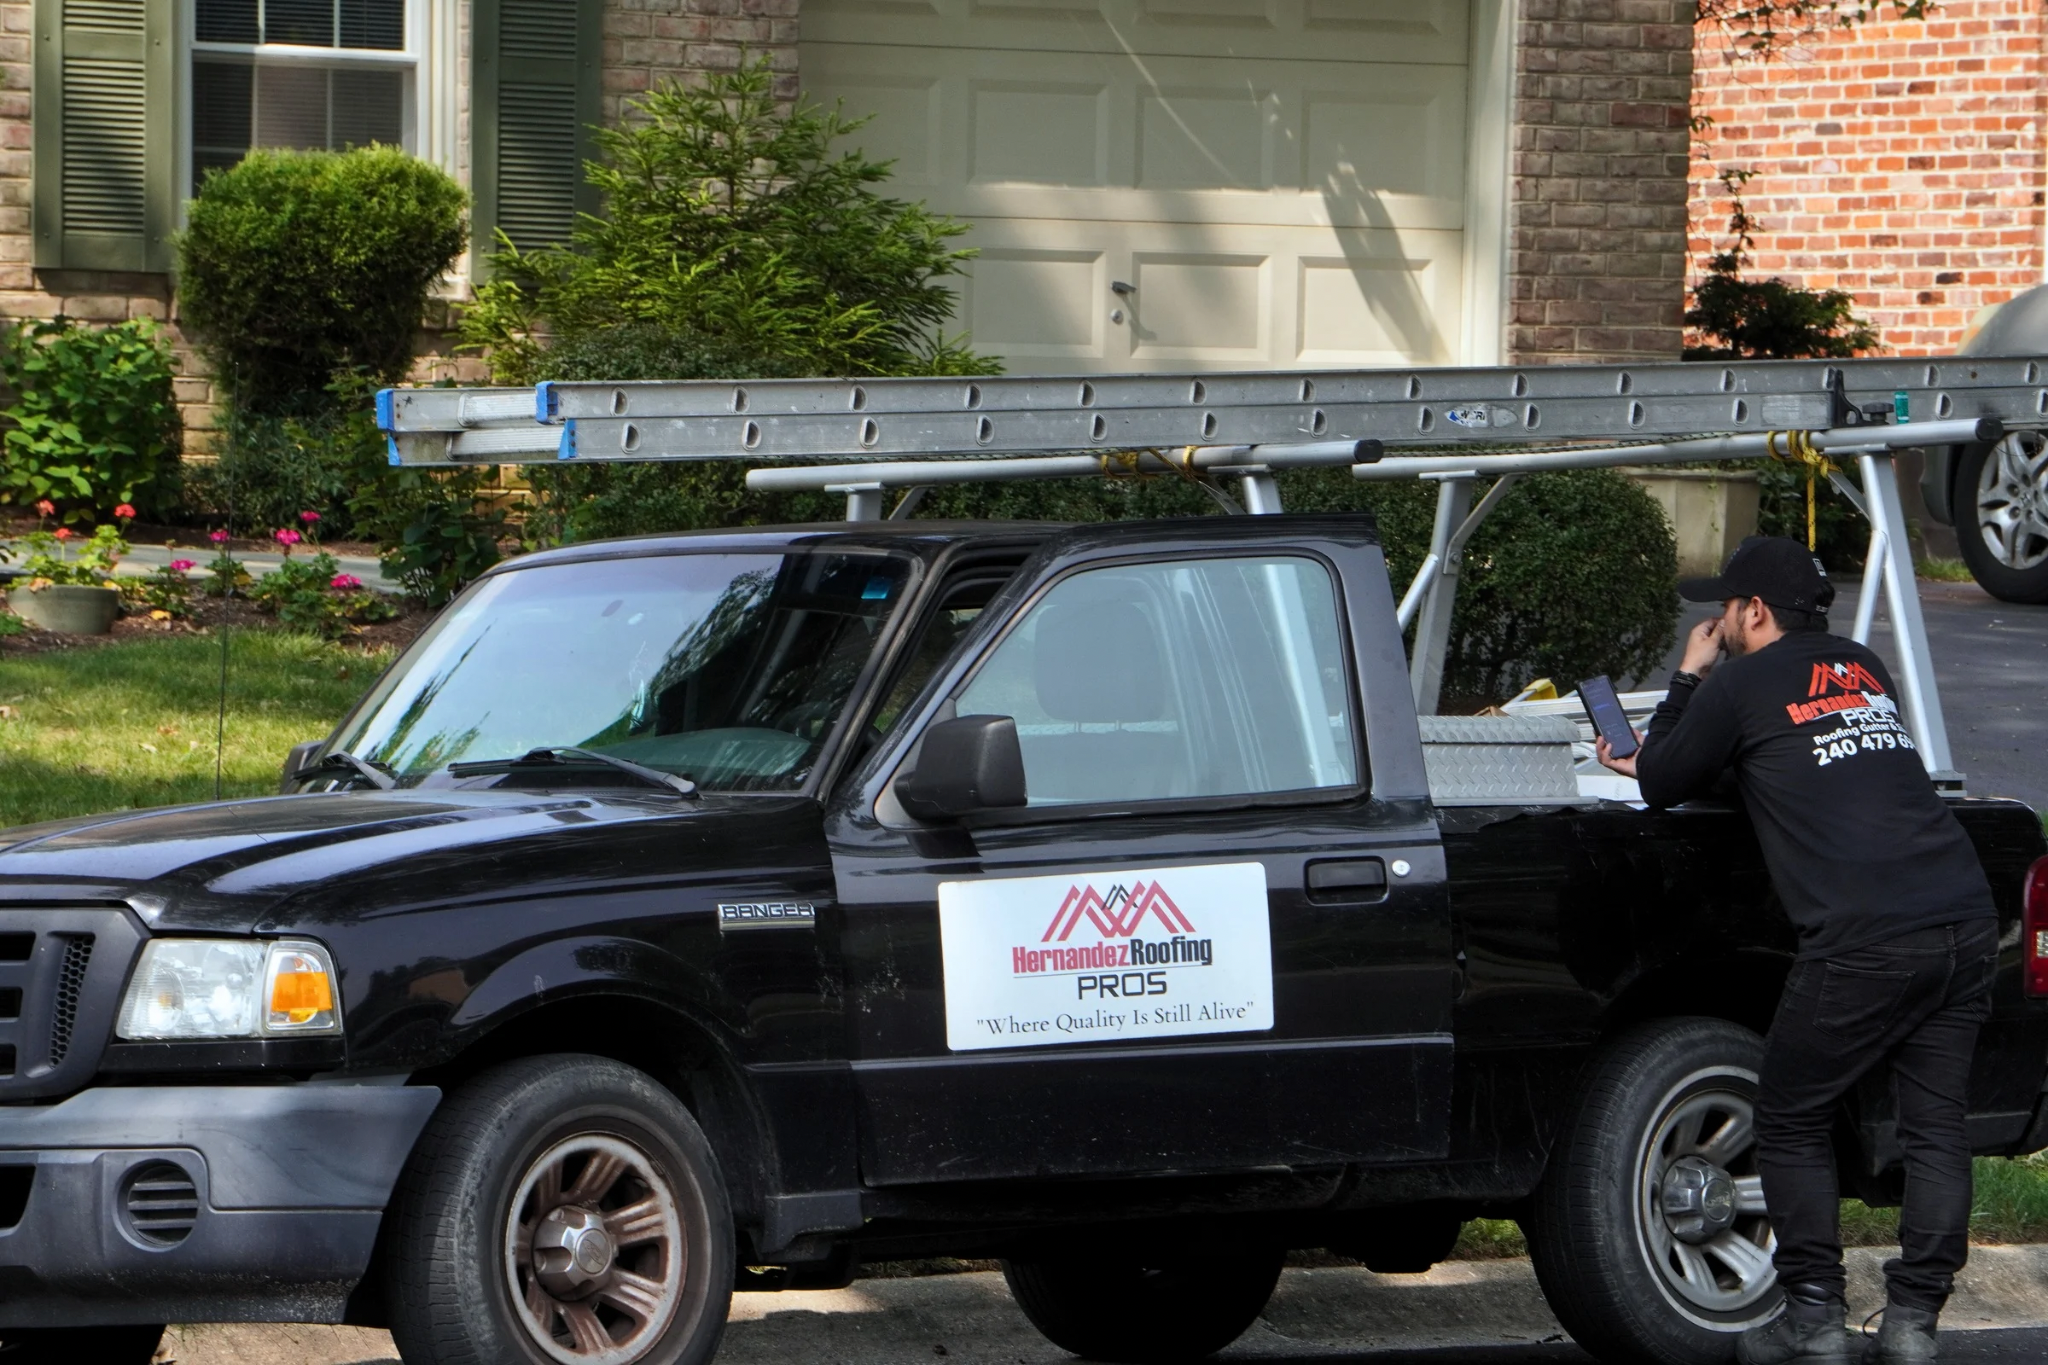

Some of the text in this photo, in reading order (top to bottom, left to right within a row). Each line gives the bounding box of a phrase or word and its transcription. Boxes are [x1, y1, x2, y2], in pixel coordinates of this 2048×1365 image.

[1840, 708, 1895, 727] PROS
[1813, 727, 1861, 746] Roofing
[1859, 722, 1891, 733] Gutter
[1812, 738, 1858, 767] 240
[1861, 732, 1896, 750] 479
[722, 902, 815, 919] RANGER
[1077, 970, 1168, 1000] PROS
[976, 1000, 1254, 1035] "Where Quality Is Still Alive"
